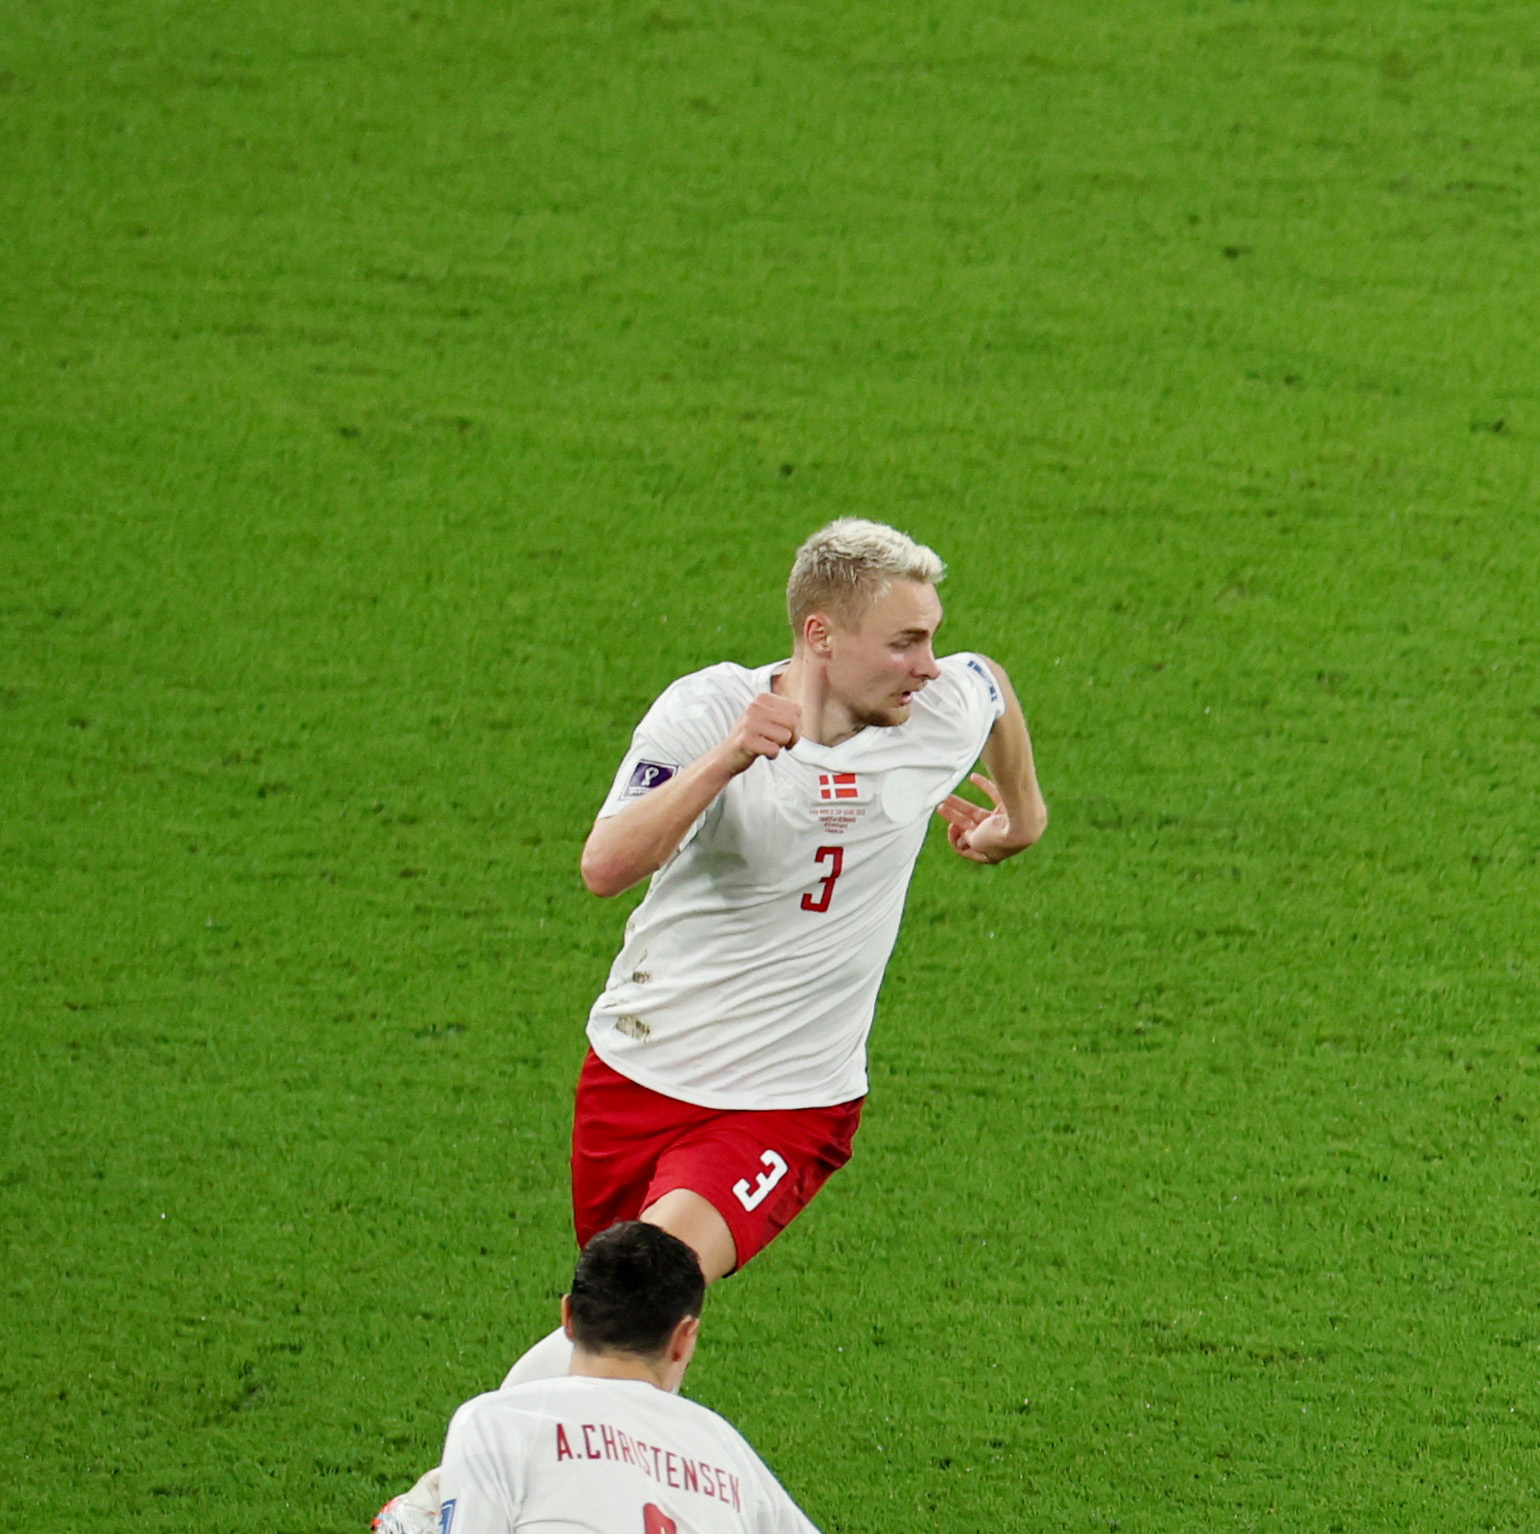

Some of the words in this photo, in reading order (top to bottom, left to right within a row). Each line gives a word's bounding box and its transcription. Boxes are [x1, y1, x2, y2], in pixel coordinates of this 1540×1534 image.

[801, 846, 844, 912] 3
[732, 1149, 788, 1212] 3
[556, 1423, 742, 1513] A.CHRISTENSEN
